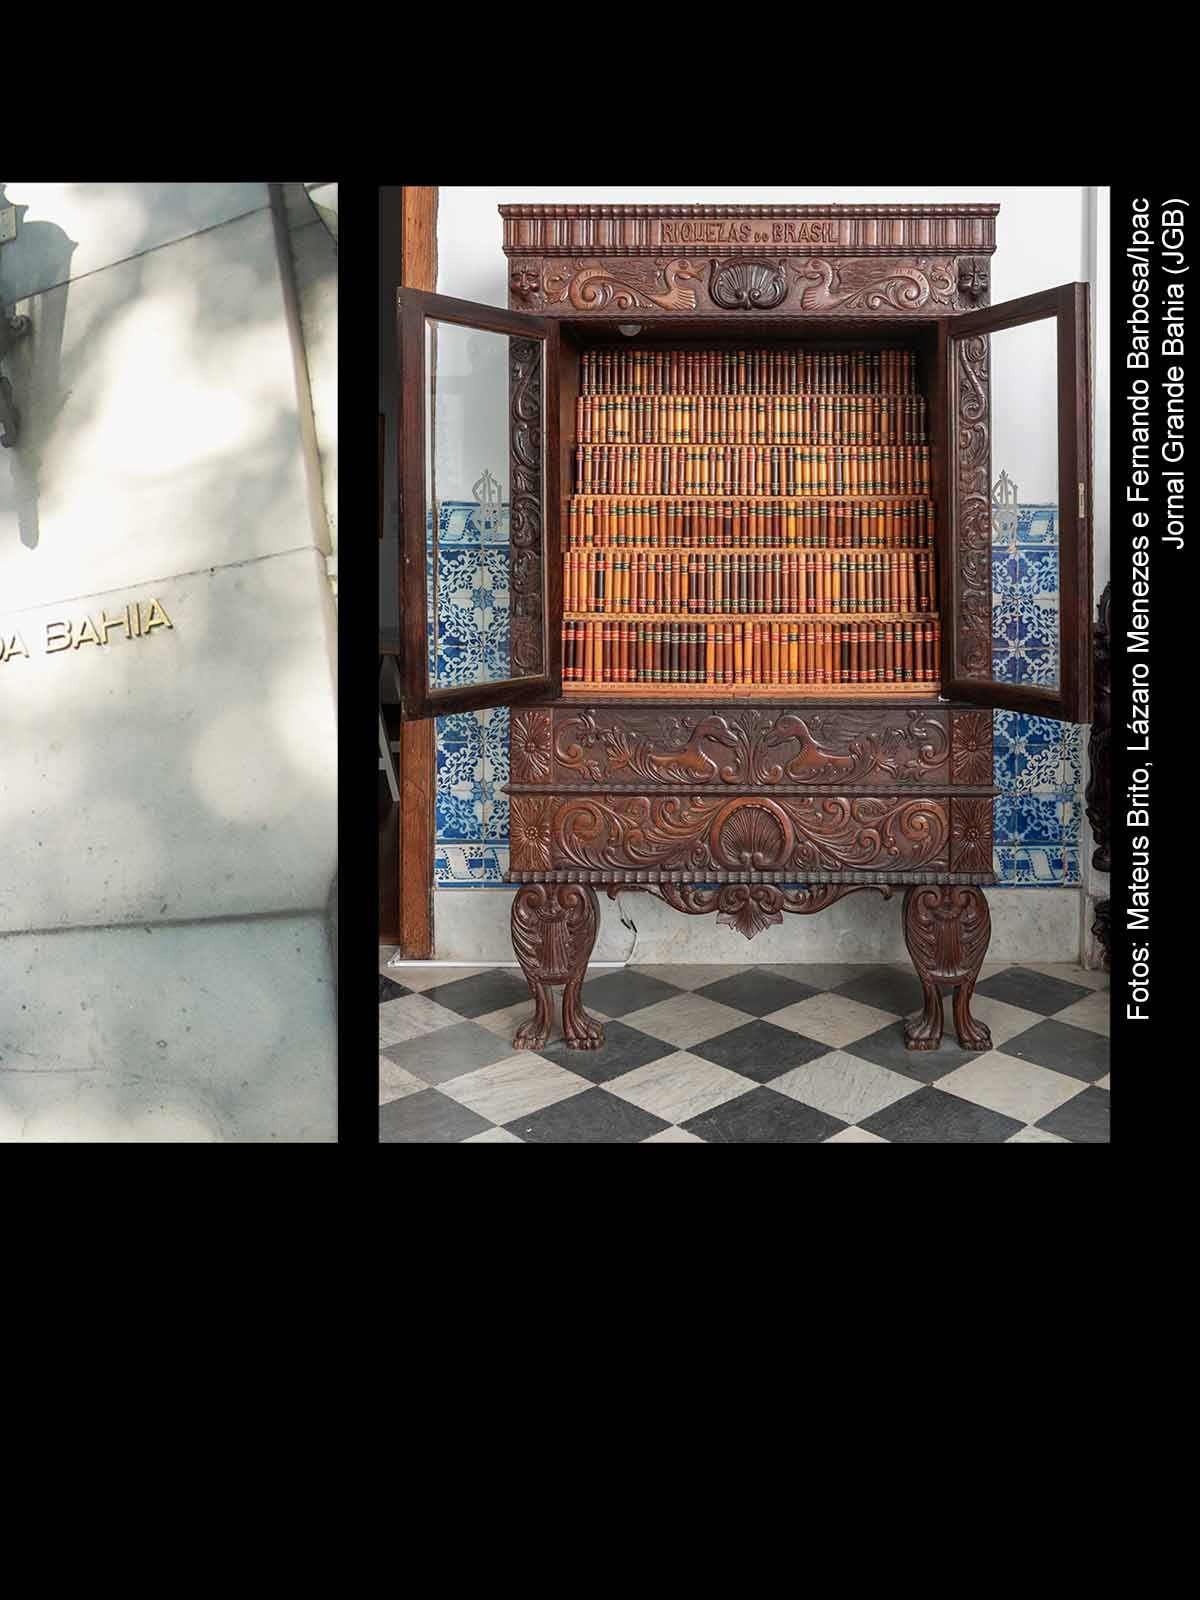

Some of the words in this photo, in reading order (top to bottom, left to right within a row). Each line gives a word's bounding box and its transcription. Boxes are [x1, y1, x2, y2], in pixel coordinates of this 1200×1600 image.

[661, 222, 752, 243] RIQUEZAS
[772, 222, 838, 243] BRASIL
[45, 597, 175, 654] BAHIA
